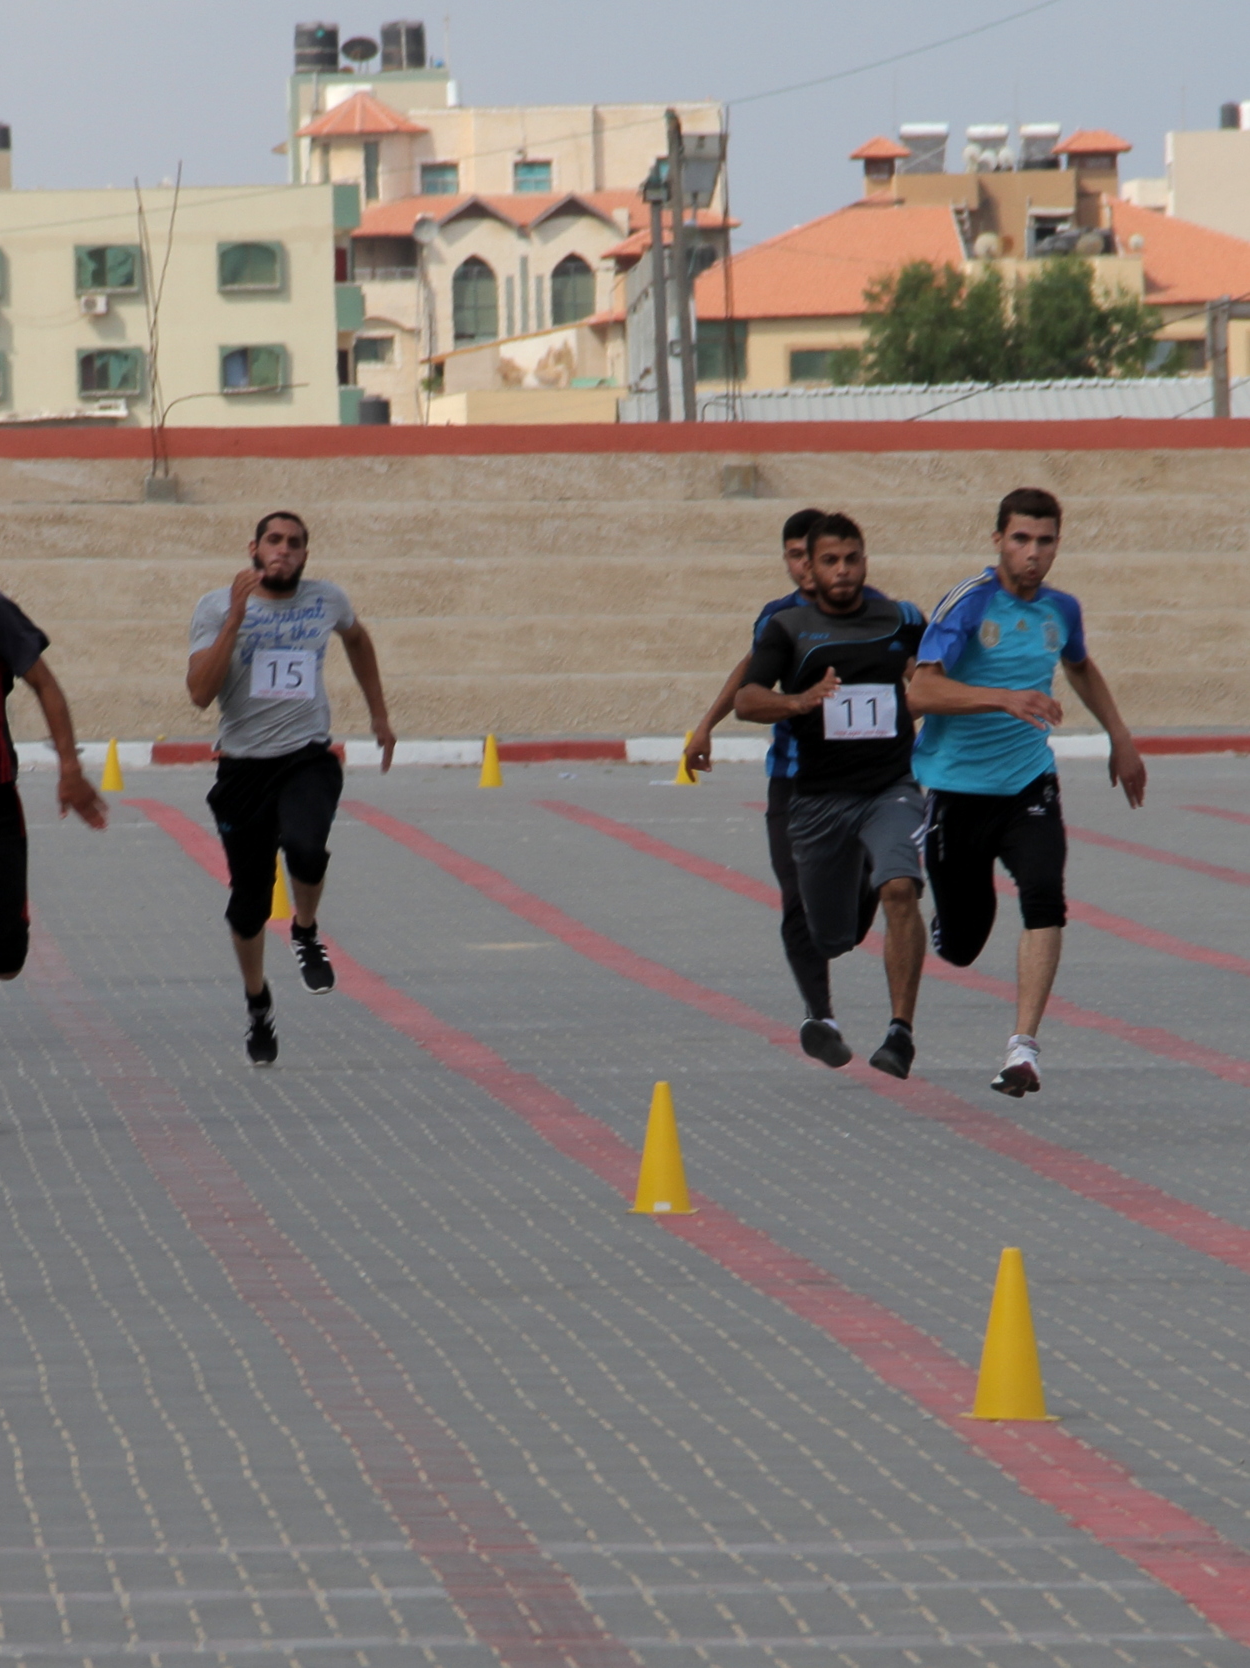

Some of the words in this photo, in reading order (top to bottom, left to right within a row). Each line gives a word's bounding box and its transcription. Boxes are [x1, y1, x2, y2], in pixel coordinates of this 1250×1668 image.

[290, 621, 321, 641] the
[266, 660, 304, 690] 15
[841, 697, 877, 728] 11
